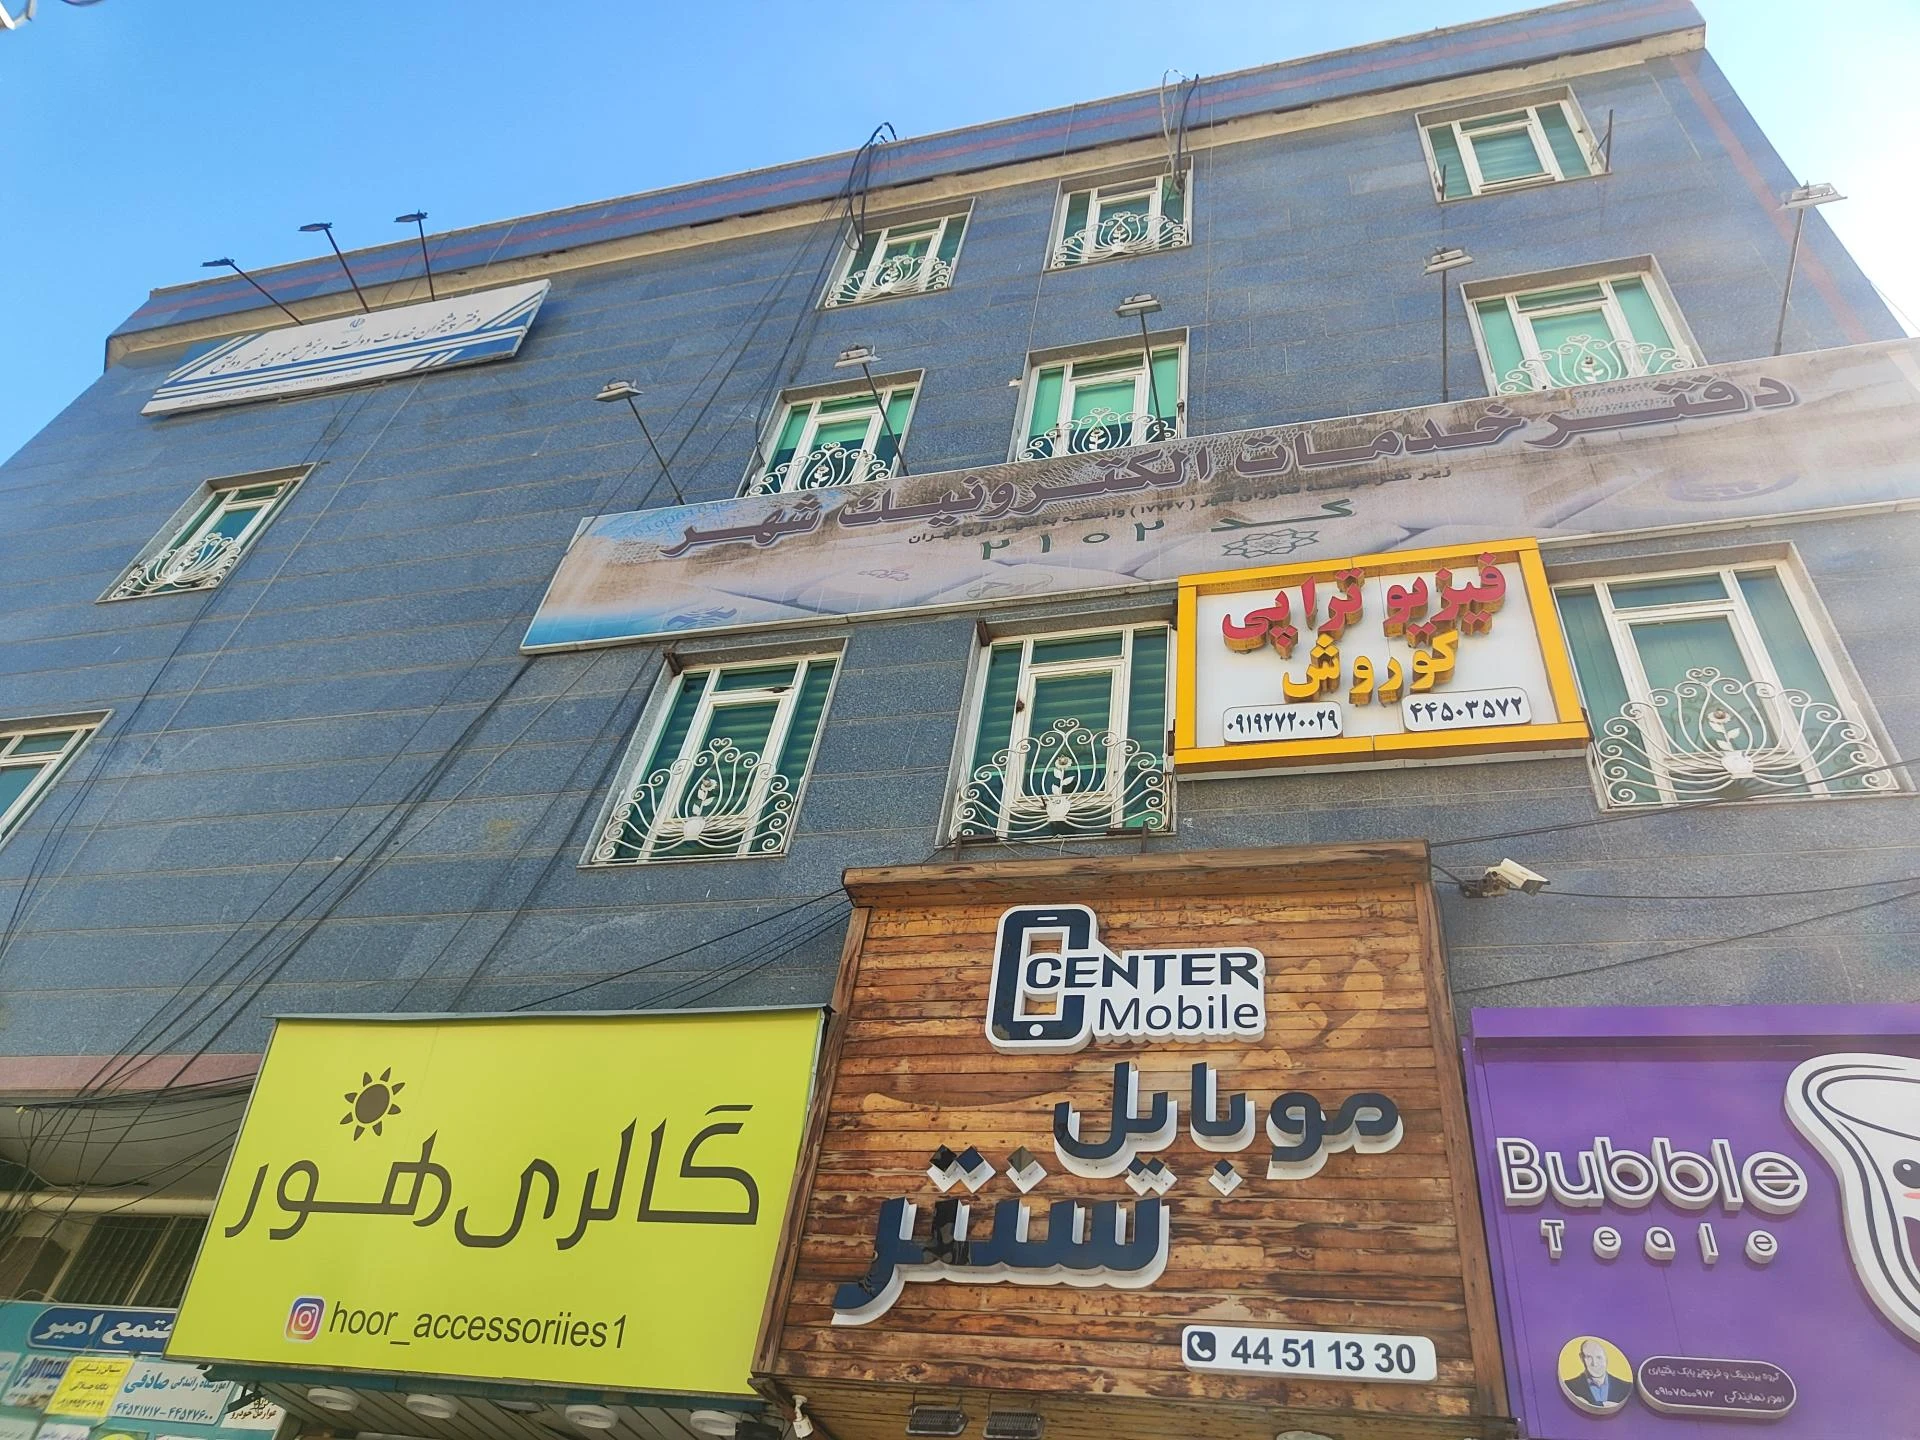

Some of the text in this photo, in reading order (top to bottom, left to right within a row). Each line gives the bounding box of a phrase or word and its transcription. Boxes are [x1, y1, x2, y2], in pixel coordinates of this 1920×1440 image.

[1524, 374, 1797, 449] دفتر
[1234, 403, 1526, 477] خدمات
[836, 446, 1211, 528] الکترونیک
[1417, 466, 1452, 482] زیر
[658, 493, 826, 558] شهر
[1210, 498, 1357, 533] کد
[1281, 629, 1459, 706] کوروش
[1227, 709, 1339, 734] ۰۹۱۹۲۷۲۰۰۲۹
[1409, 696, 1522, 723] ۴۴۵۰۳۵۷۲
[1025, 952, 1259, 995] CENTER
[1098, 993, 1259, 1031] Mobile
[1053, 1061, 1404, 1197] موبایل
[224, 1104, 761, 1250] گالری هور
[1496, 1135, 1808, 1215] Bubble
[830, 1143, 1171, 1326] سنتر
[1540, 1218, 1779, 1265] Teale
[33, 1312, 105, 1340] امیر
[329, 1301, 628, 1350] hoor_accessoriies1
[1231, 1335, 1416, 1374] 44 51 13 30
[123, 1369, 170, 1394] صادقی
